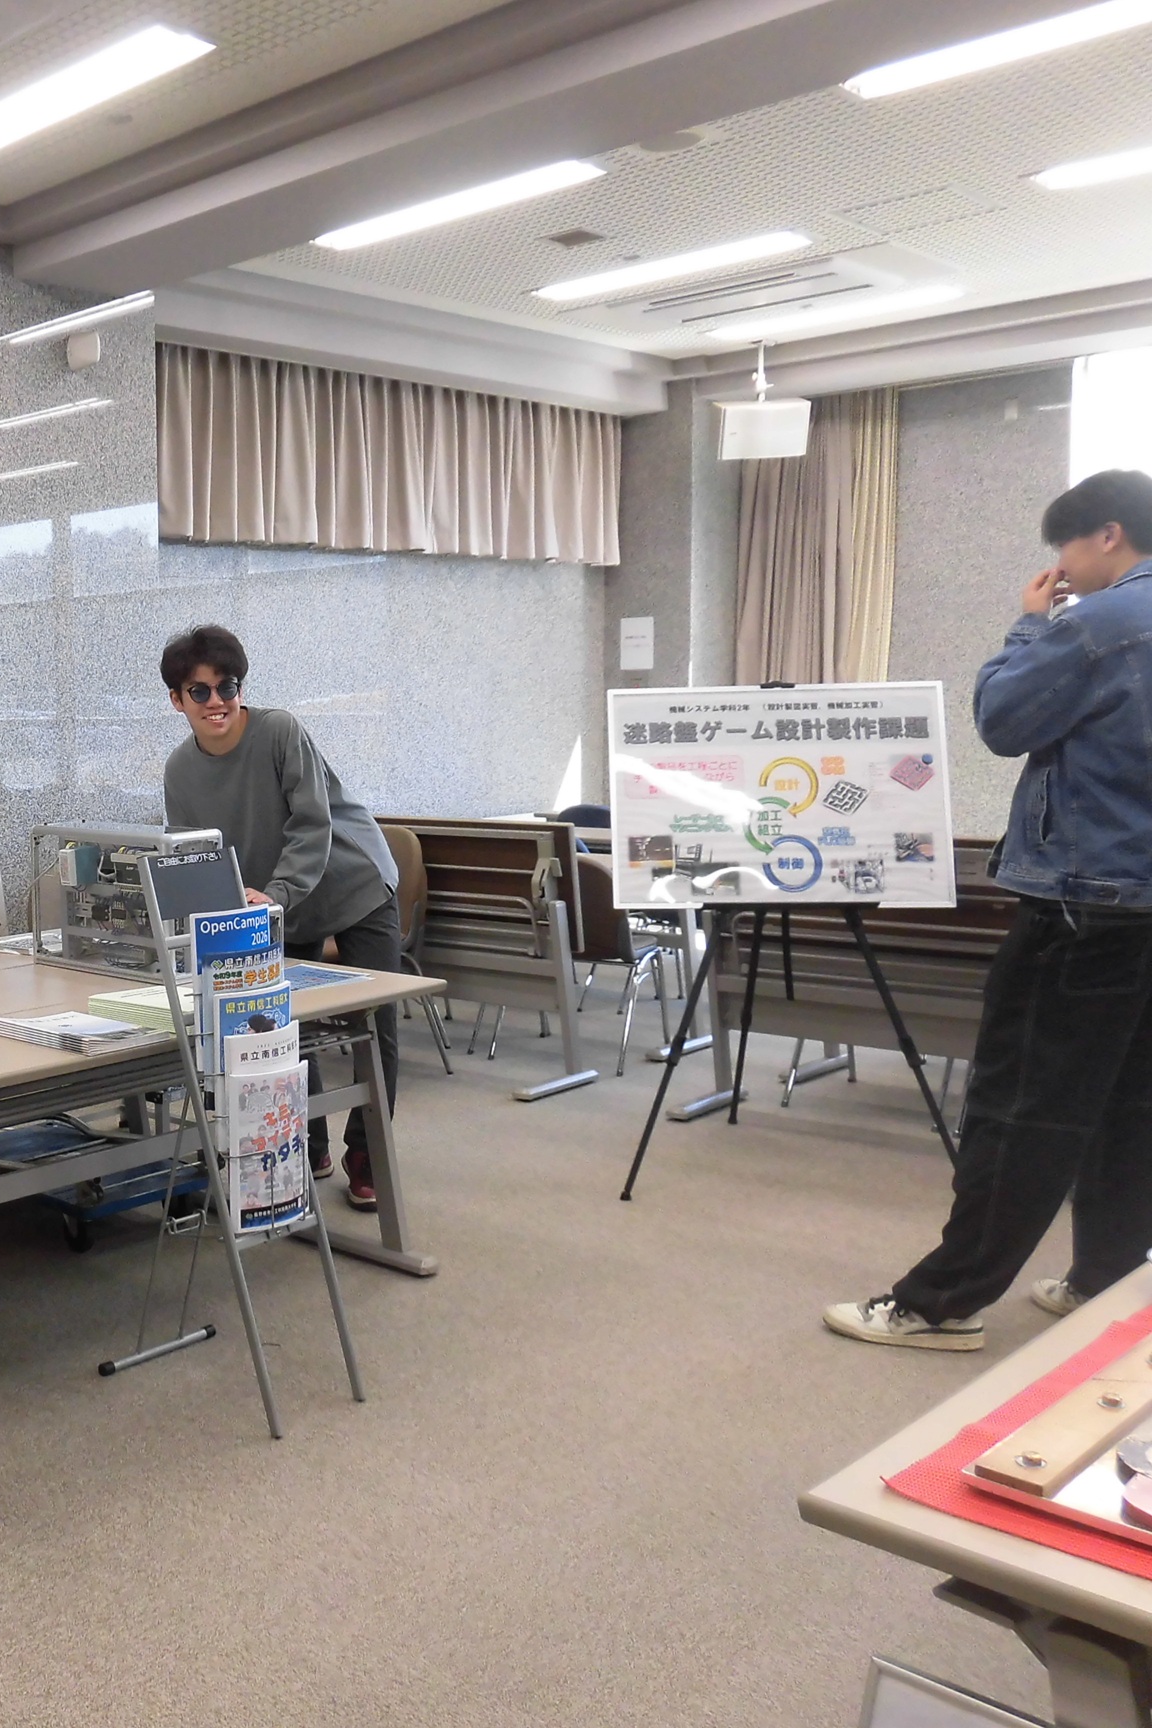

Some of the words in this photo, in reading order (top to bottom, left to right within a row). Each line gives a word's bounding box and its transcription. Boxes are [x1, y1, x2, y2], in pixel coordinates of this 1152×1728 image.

[622, 715, 931, 745] 迷路盤ゲーム設計製作課題
[757, 809, 782, 822] 加工
[757, 823, 783, 836] 組立
[156, 851, 223, 868] ご自由にお取り下さい
[777, 856, 805, 870] 制御
[200, 914, 268, 936] OpenCampus
[251, 930, 268, 946] 2026
